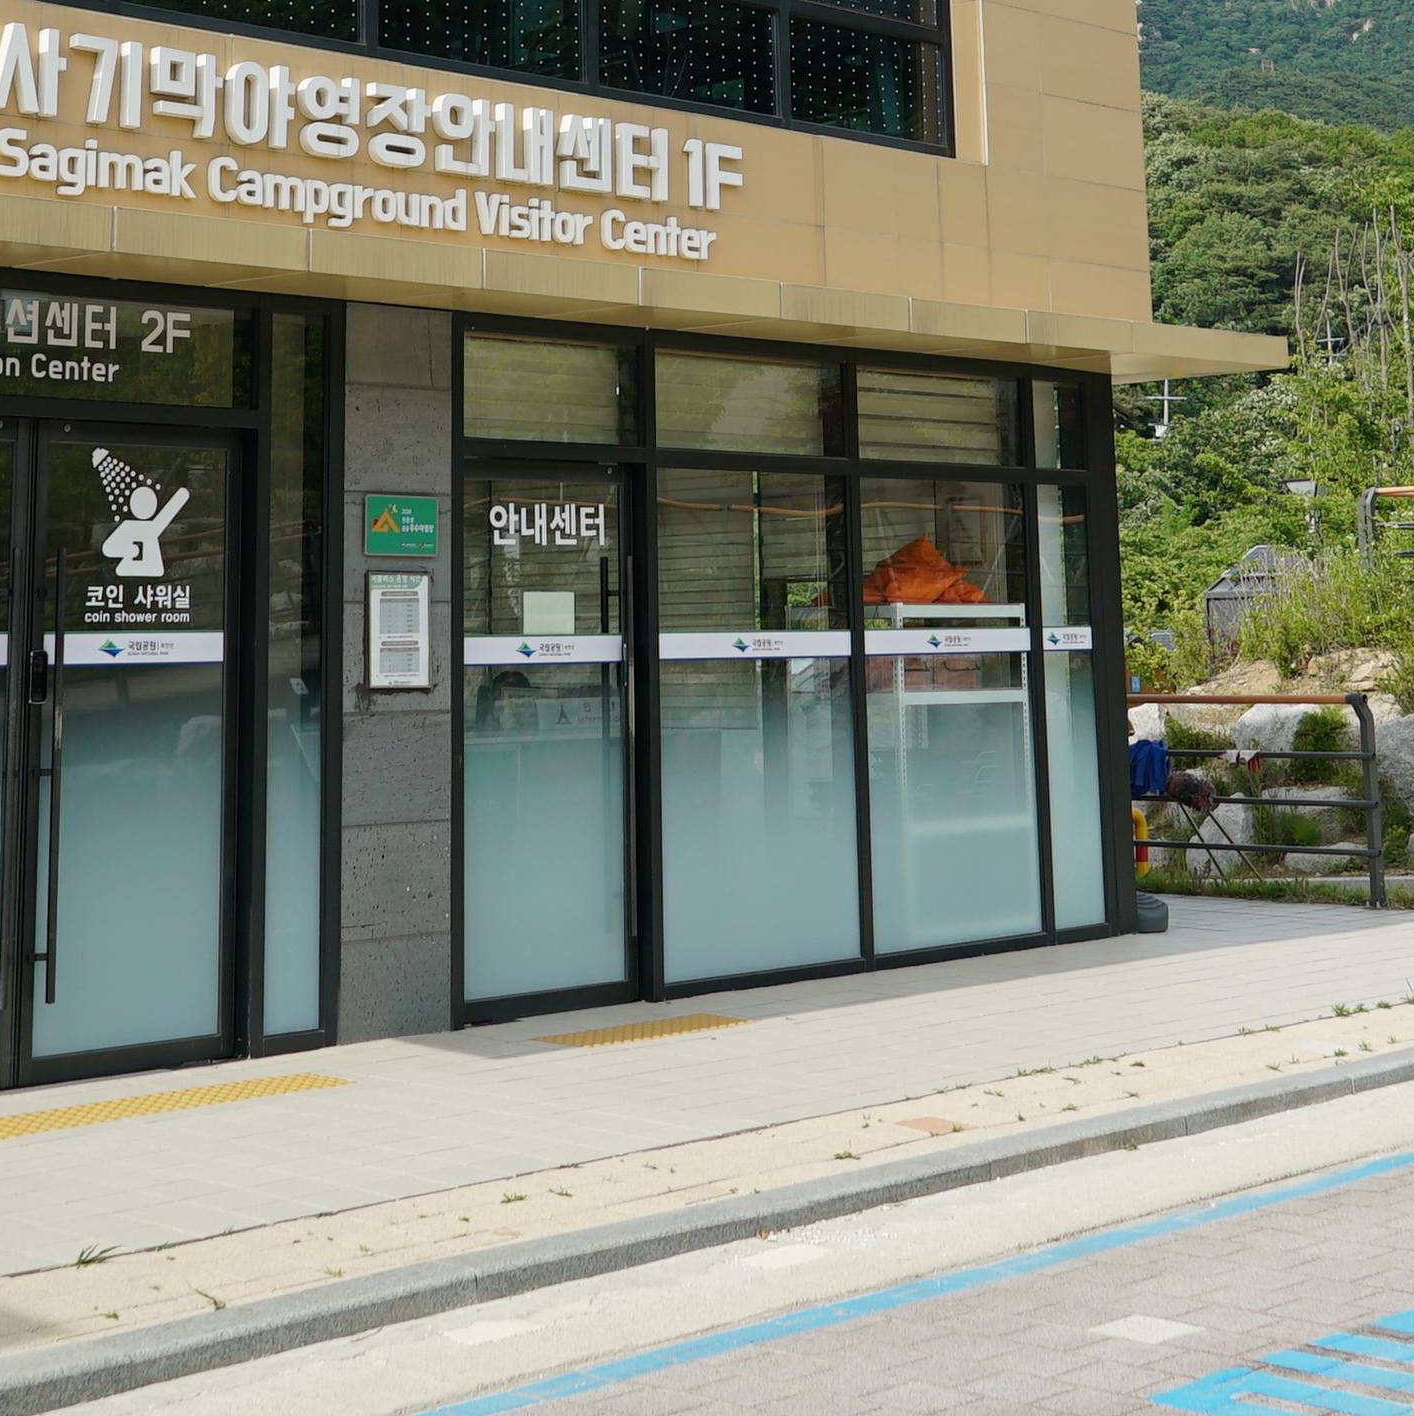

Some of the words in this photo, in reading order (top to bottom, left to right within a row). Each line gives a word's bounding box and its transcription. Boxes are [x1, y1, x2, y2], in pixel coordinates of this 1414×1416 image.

[680, 136, 744, 211] 1F
[206, 154, 467, 233] Campground
[476, 190, 590, 248] Visitor
[599, 208, 718, 263] Center
[140, 309, 192, 354] 2F
[30, 352, 120, 383] Center
[489, 501, 606, 547] 안내센터
[84, 610, 111, 624] coin
[114, 610, 157, 624] shower
[160, 612, 190, 624] room
[85, 585, 124, 610] 코인
[133, 584, 191, 610] 샤워실
